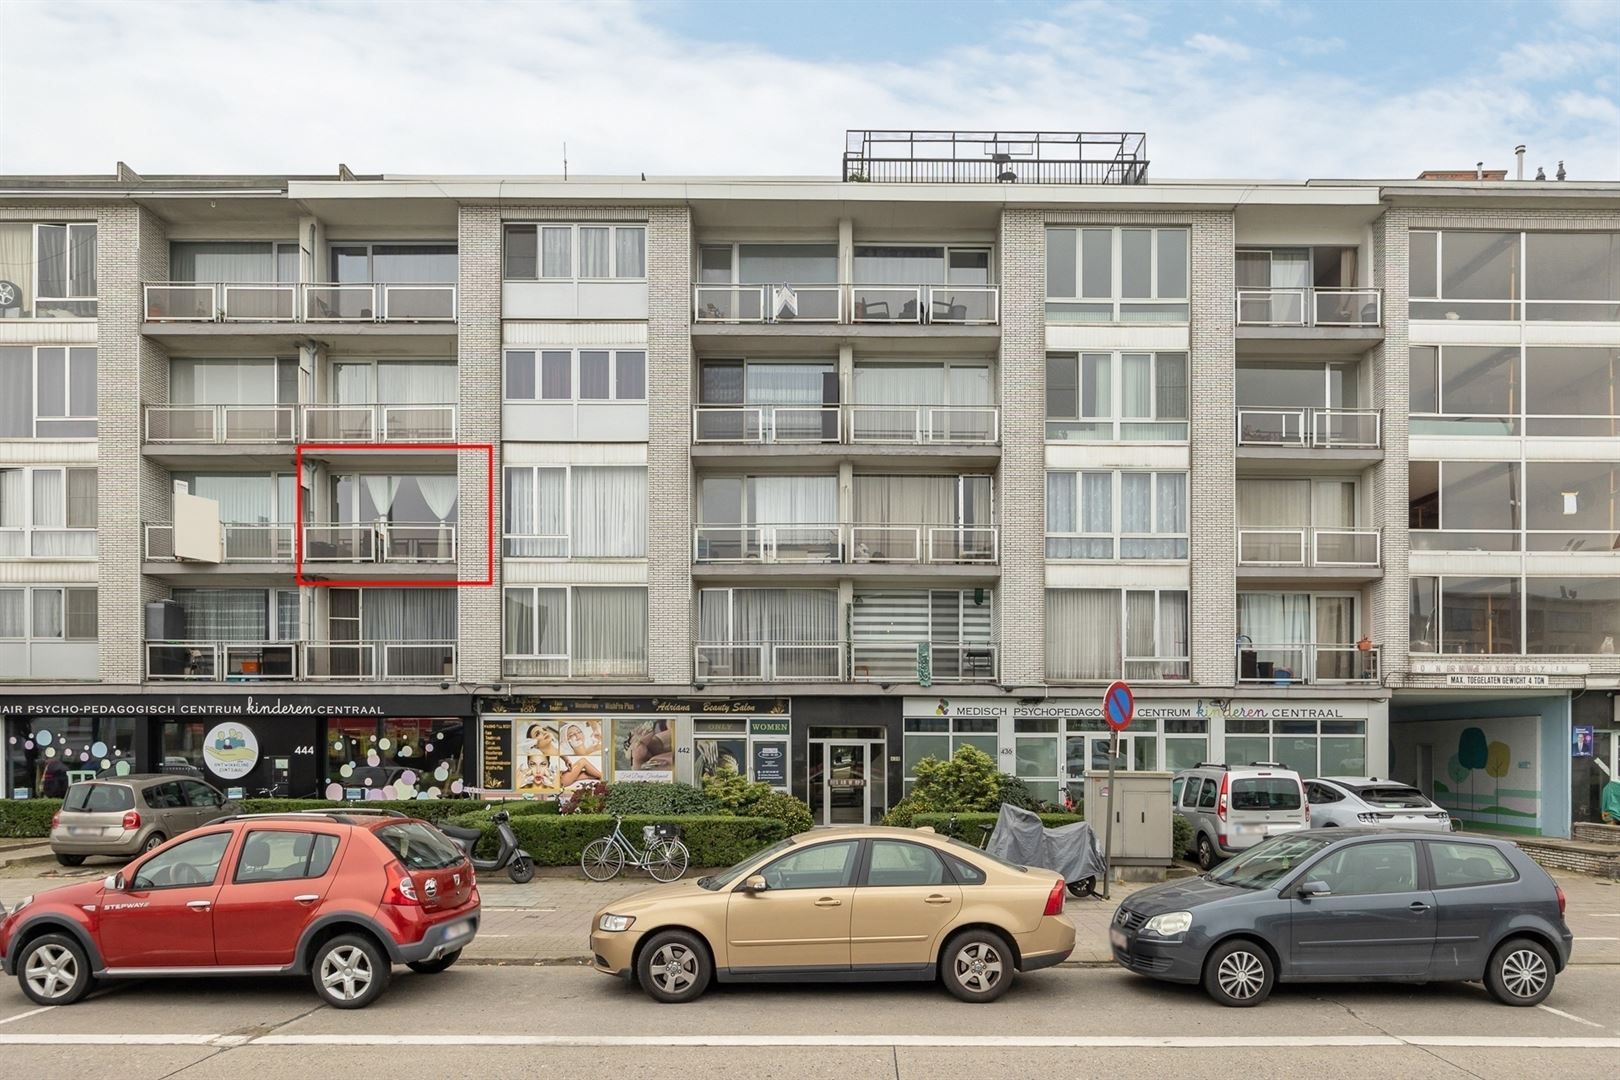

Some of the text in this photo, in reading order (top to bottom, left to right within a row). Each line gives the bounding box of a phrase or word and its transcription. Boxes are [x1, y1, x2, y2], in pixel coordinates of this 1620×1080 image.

[1450, 676, 1545, 684] MAX. TOEGELATEN GEWICHT 4 TON
[0, 696, 385, 715] AIR PSYCHO-PEDAGOGISCH CENTRUM kinderen CENTRAAL
[656, 701, 756, 713] Adriana Beauty Salon
[957, 707, 1007, 716] MEDISCH
[1138, 708, 1191, 717] CENTRUM
[1196, 699, 1269, 718] kinderen
[1272, 708, 1344, 718] CENTRAAL
[752, 723, 788, 731] WOMEN
[295, 746, 314, 755] 444
[678, 746, 690, 754] 442
[1000, 747, 1013, 755] 436
[104, 902, 145, 910] STEPWAY
